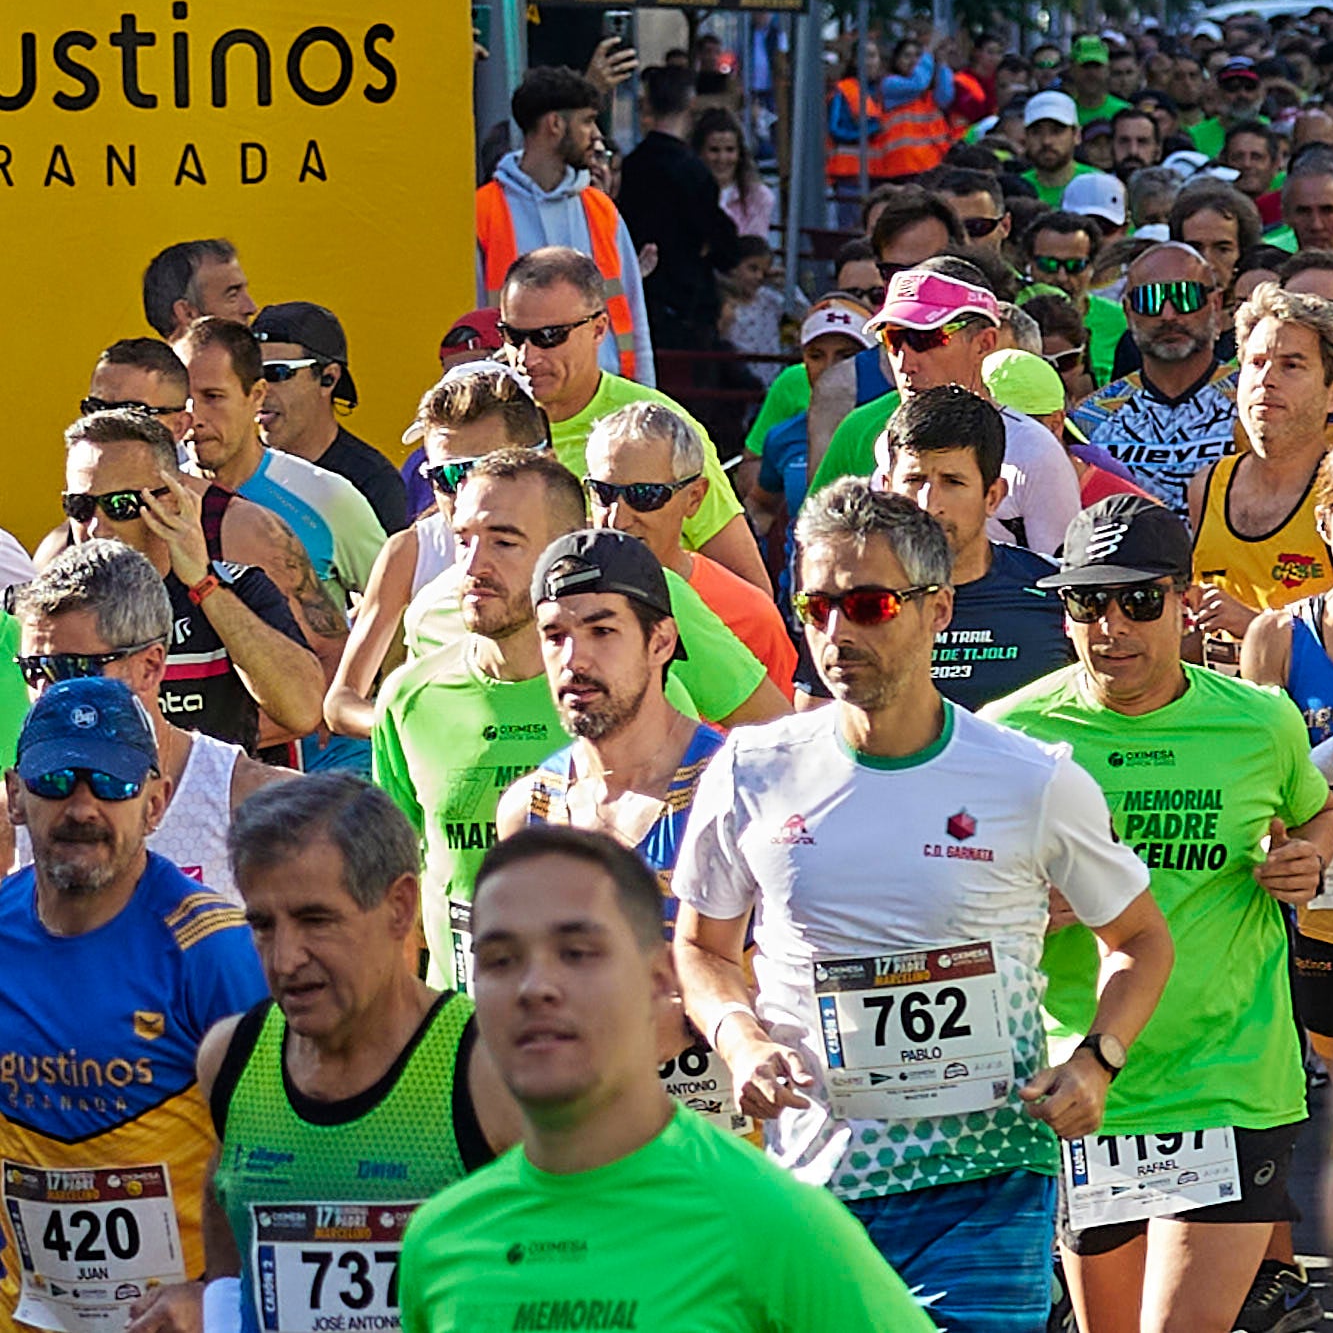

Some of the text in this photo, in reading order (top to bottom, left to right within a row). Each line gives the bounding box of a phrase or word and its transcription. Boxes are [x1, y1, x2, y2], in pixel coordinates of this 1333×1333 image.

[951, 629, 994, 643] TRAIL
[940, 648, 960, 661] DE
[930, 665, 972, 679] 2023
[1125, 749, 1175, 761] OXIMESA
[1123, 788, 1223, 812] MEMORIAL
[1125, 813, 1218, 840] PADRE
[862, 986, 972, 1047] 762
[900, 1046, 942, 1062] PABLO
[1137, 1159, 1179, 1177] RAFAEL
[42, 1207, 141, 1263] 420
[76, 1267, 110, 1280] JUAN
[312, 1314, 346, 1333] JOSÉ
[511, 1299, 638, 1333] MEMORIAL
